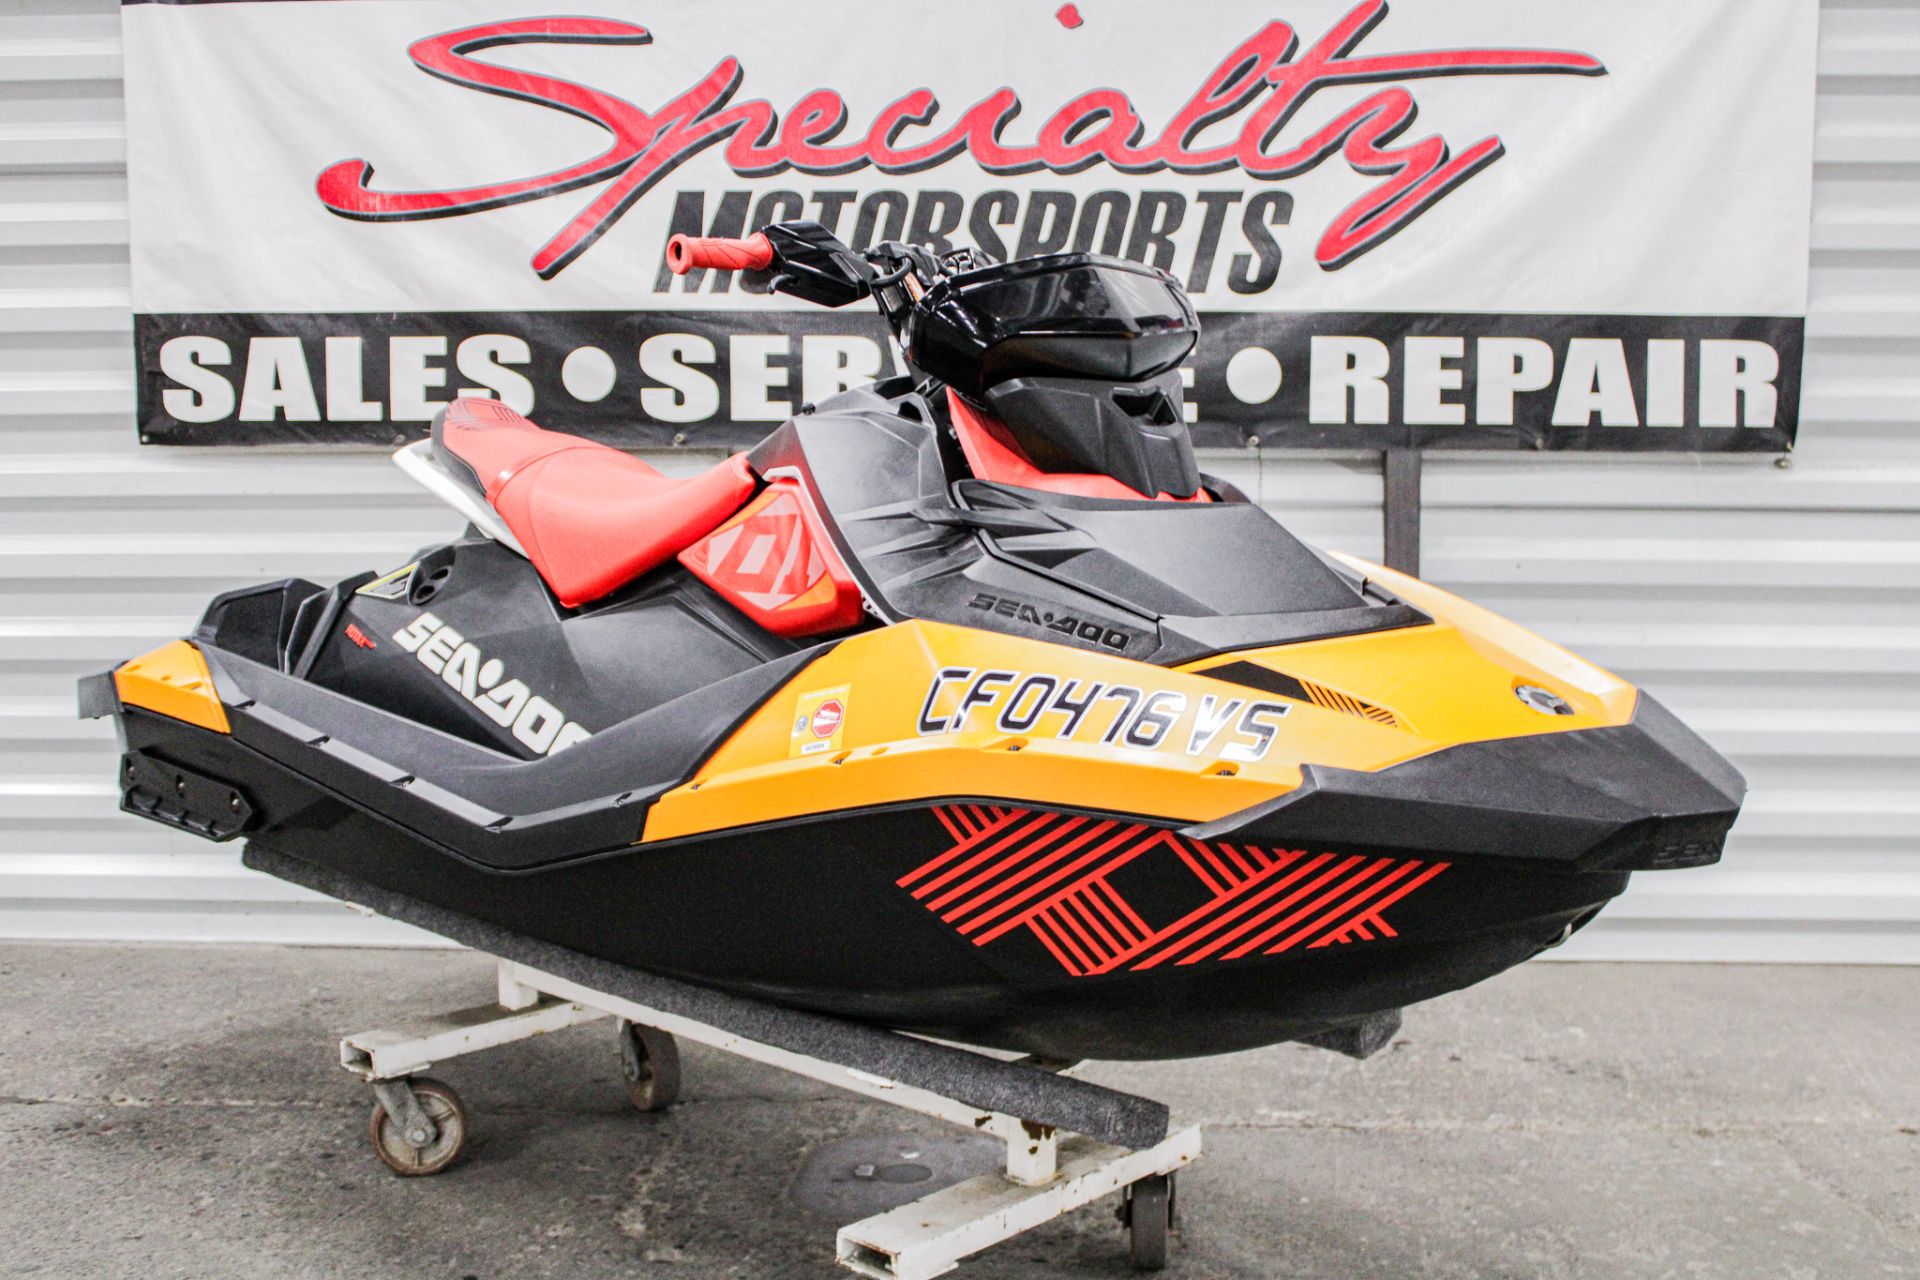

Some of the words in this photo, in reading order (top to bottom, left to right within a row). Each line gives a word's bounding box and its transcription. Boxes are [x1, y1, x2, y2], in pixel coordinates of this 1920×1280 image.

[316, 0, 1608, 279] Specialty
[652, 189, 1295, 295] MOTORSPORTS
[159, 334, 535, 423] SALES
[1309, 335, 1779, 429] REPAIR
